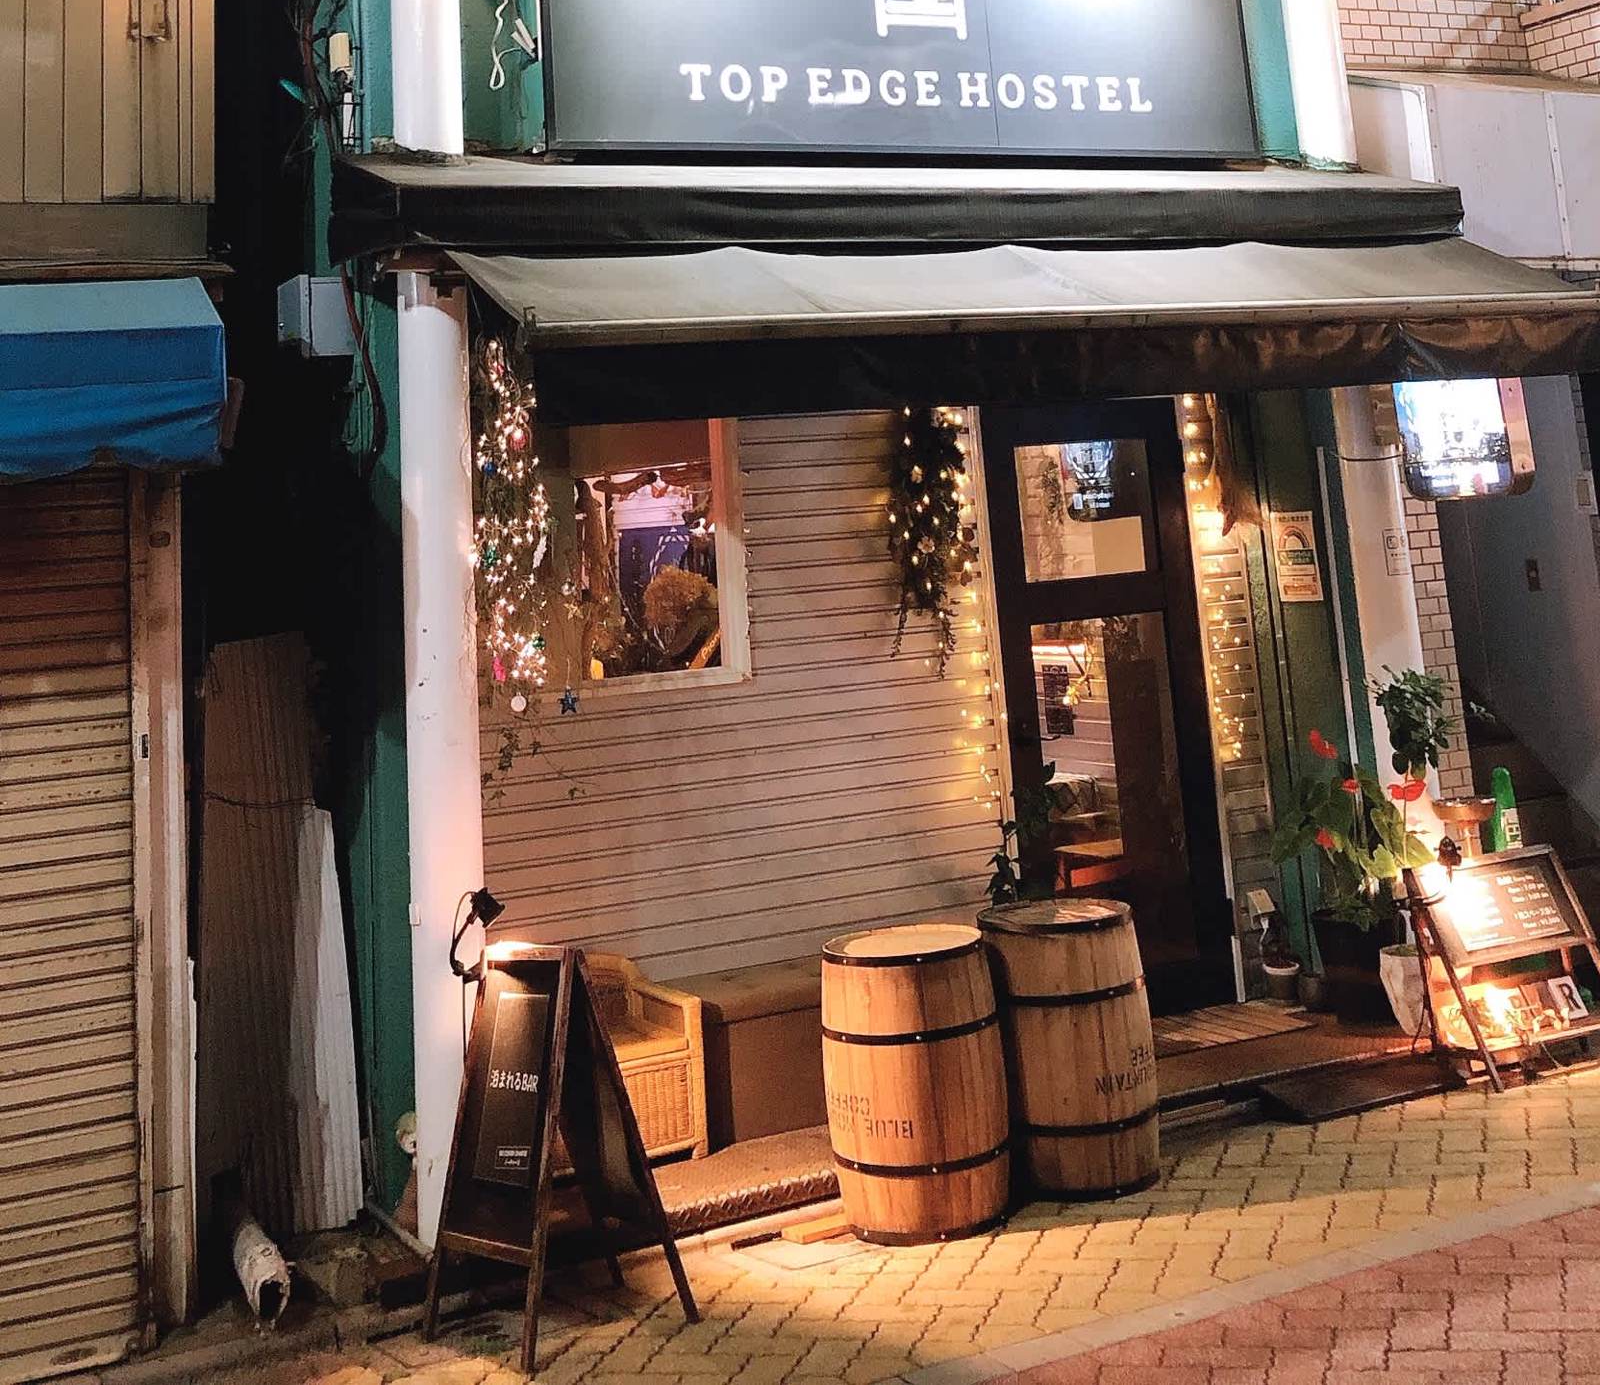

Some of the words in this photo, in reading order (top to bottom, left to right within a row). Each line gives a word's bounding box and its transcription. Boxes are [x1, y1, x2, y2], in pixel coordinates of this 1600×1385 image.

[679, 63, 788, 103] TOP
[806, 67, 942, 107] EDGE
[957, 71, 1153, 113] HOSTEL
[864, 1118, 914, 1140] BLUE
